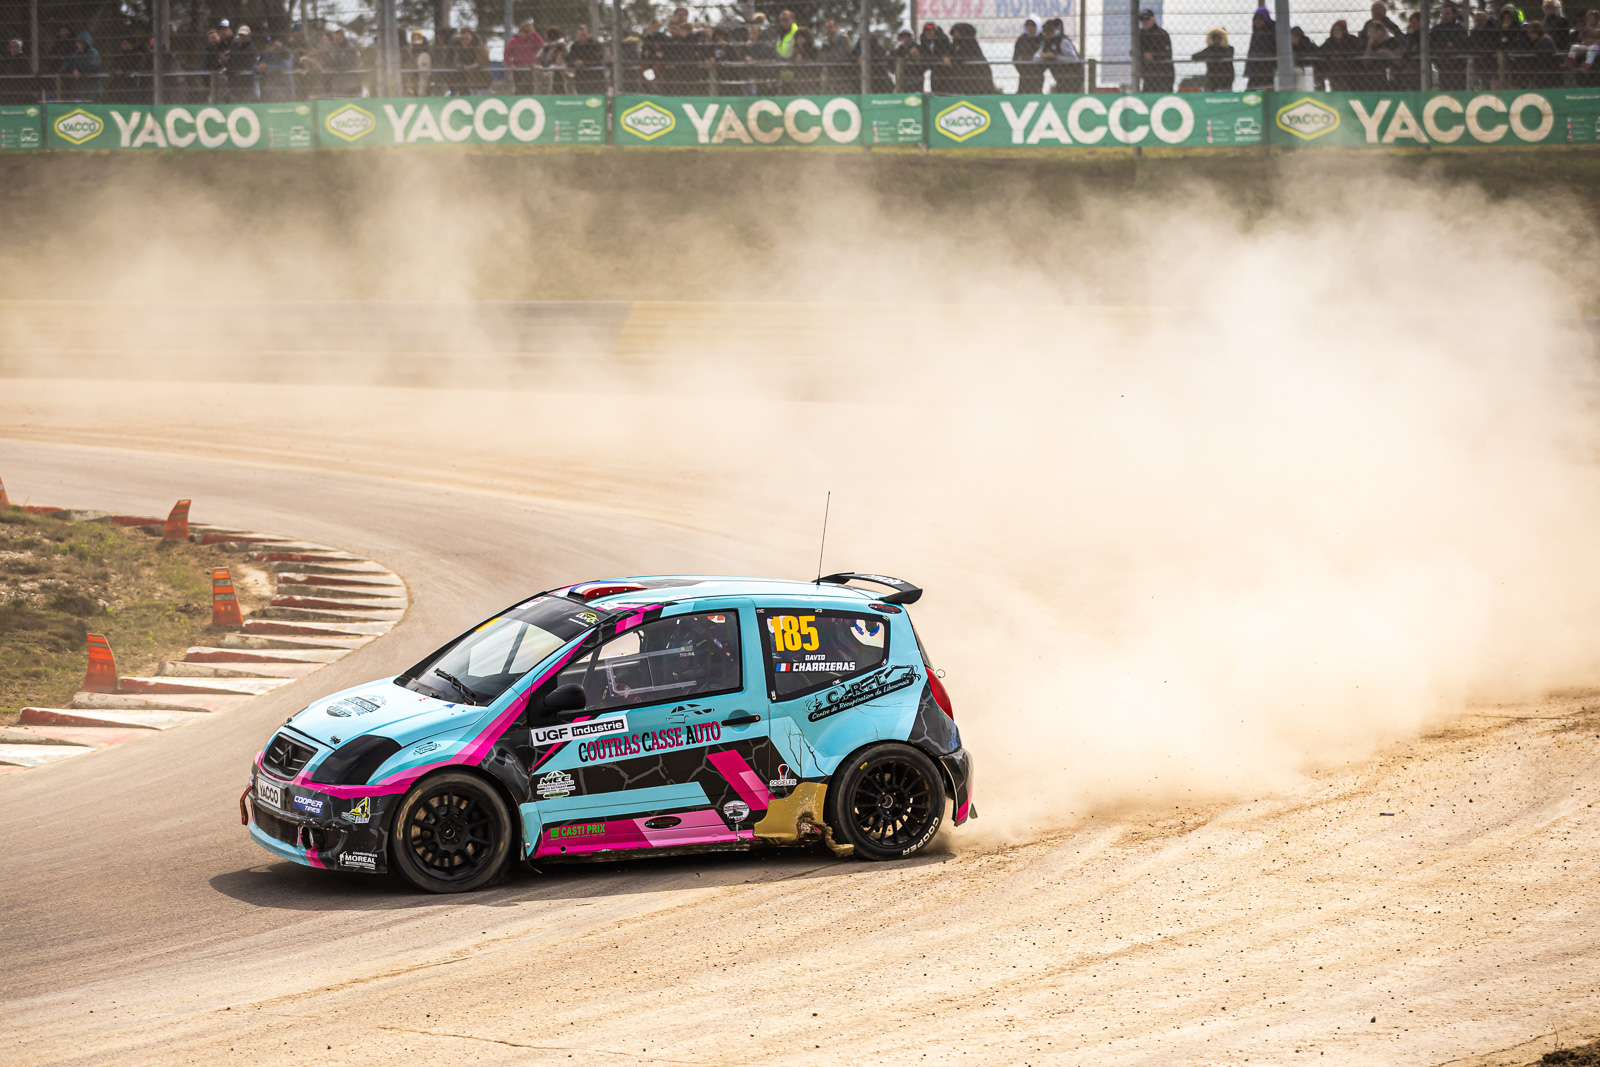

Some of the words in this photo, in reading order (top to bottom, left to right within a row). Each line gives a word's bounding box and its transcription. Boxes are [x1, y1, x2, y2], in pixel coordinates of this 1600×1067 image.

[334, 118, 369, 129] YACCO
[383, 98, 546, 143] YACCO
[631, 115, 668, 127] YACCO
[681, 97, 862, 144] YACCO
[944, 115, 982, 128] YACCO
[999, 95, 1195, 145] YACCO
[1286, 113, 1330, 126] YACCO
[1349, 92, 1554, 144] YACCO
[62, 121, 97, 133] YACCO
[110, 107, 261, 148] YACCO
[770, 615, 820, 652] 185
[792, 661, 856, 672] CHARRIERAS
[811, 709, 830, 719] Centre
[831, 705, 838, 713] de
[535, 729, 568, 743] UGF
[573, 721, 623, 737] industrie
[578, 734, 641, 762] COUTRAS
[641, 726, 684, 752] CASSE
[685, 721, 721, 745] AUTO
[260, 784, 279, 804] YACCO
[294, 795, 324, 808] COOPER
[304, 805, 321, 814] TIRES
[561, 825, 585, 837] CASTI
[586, 820, 606, 834] PRIX
[902, 816, 940, 856] COOPER
[345, 854, 377, 865] MOREAL
